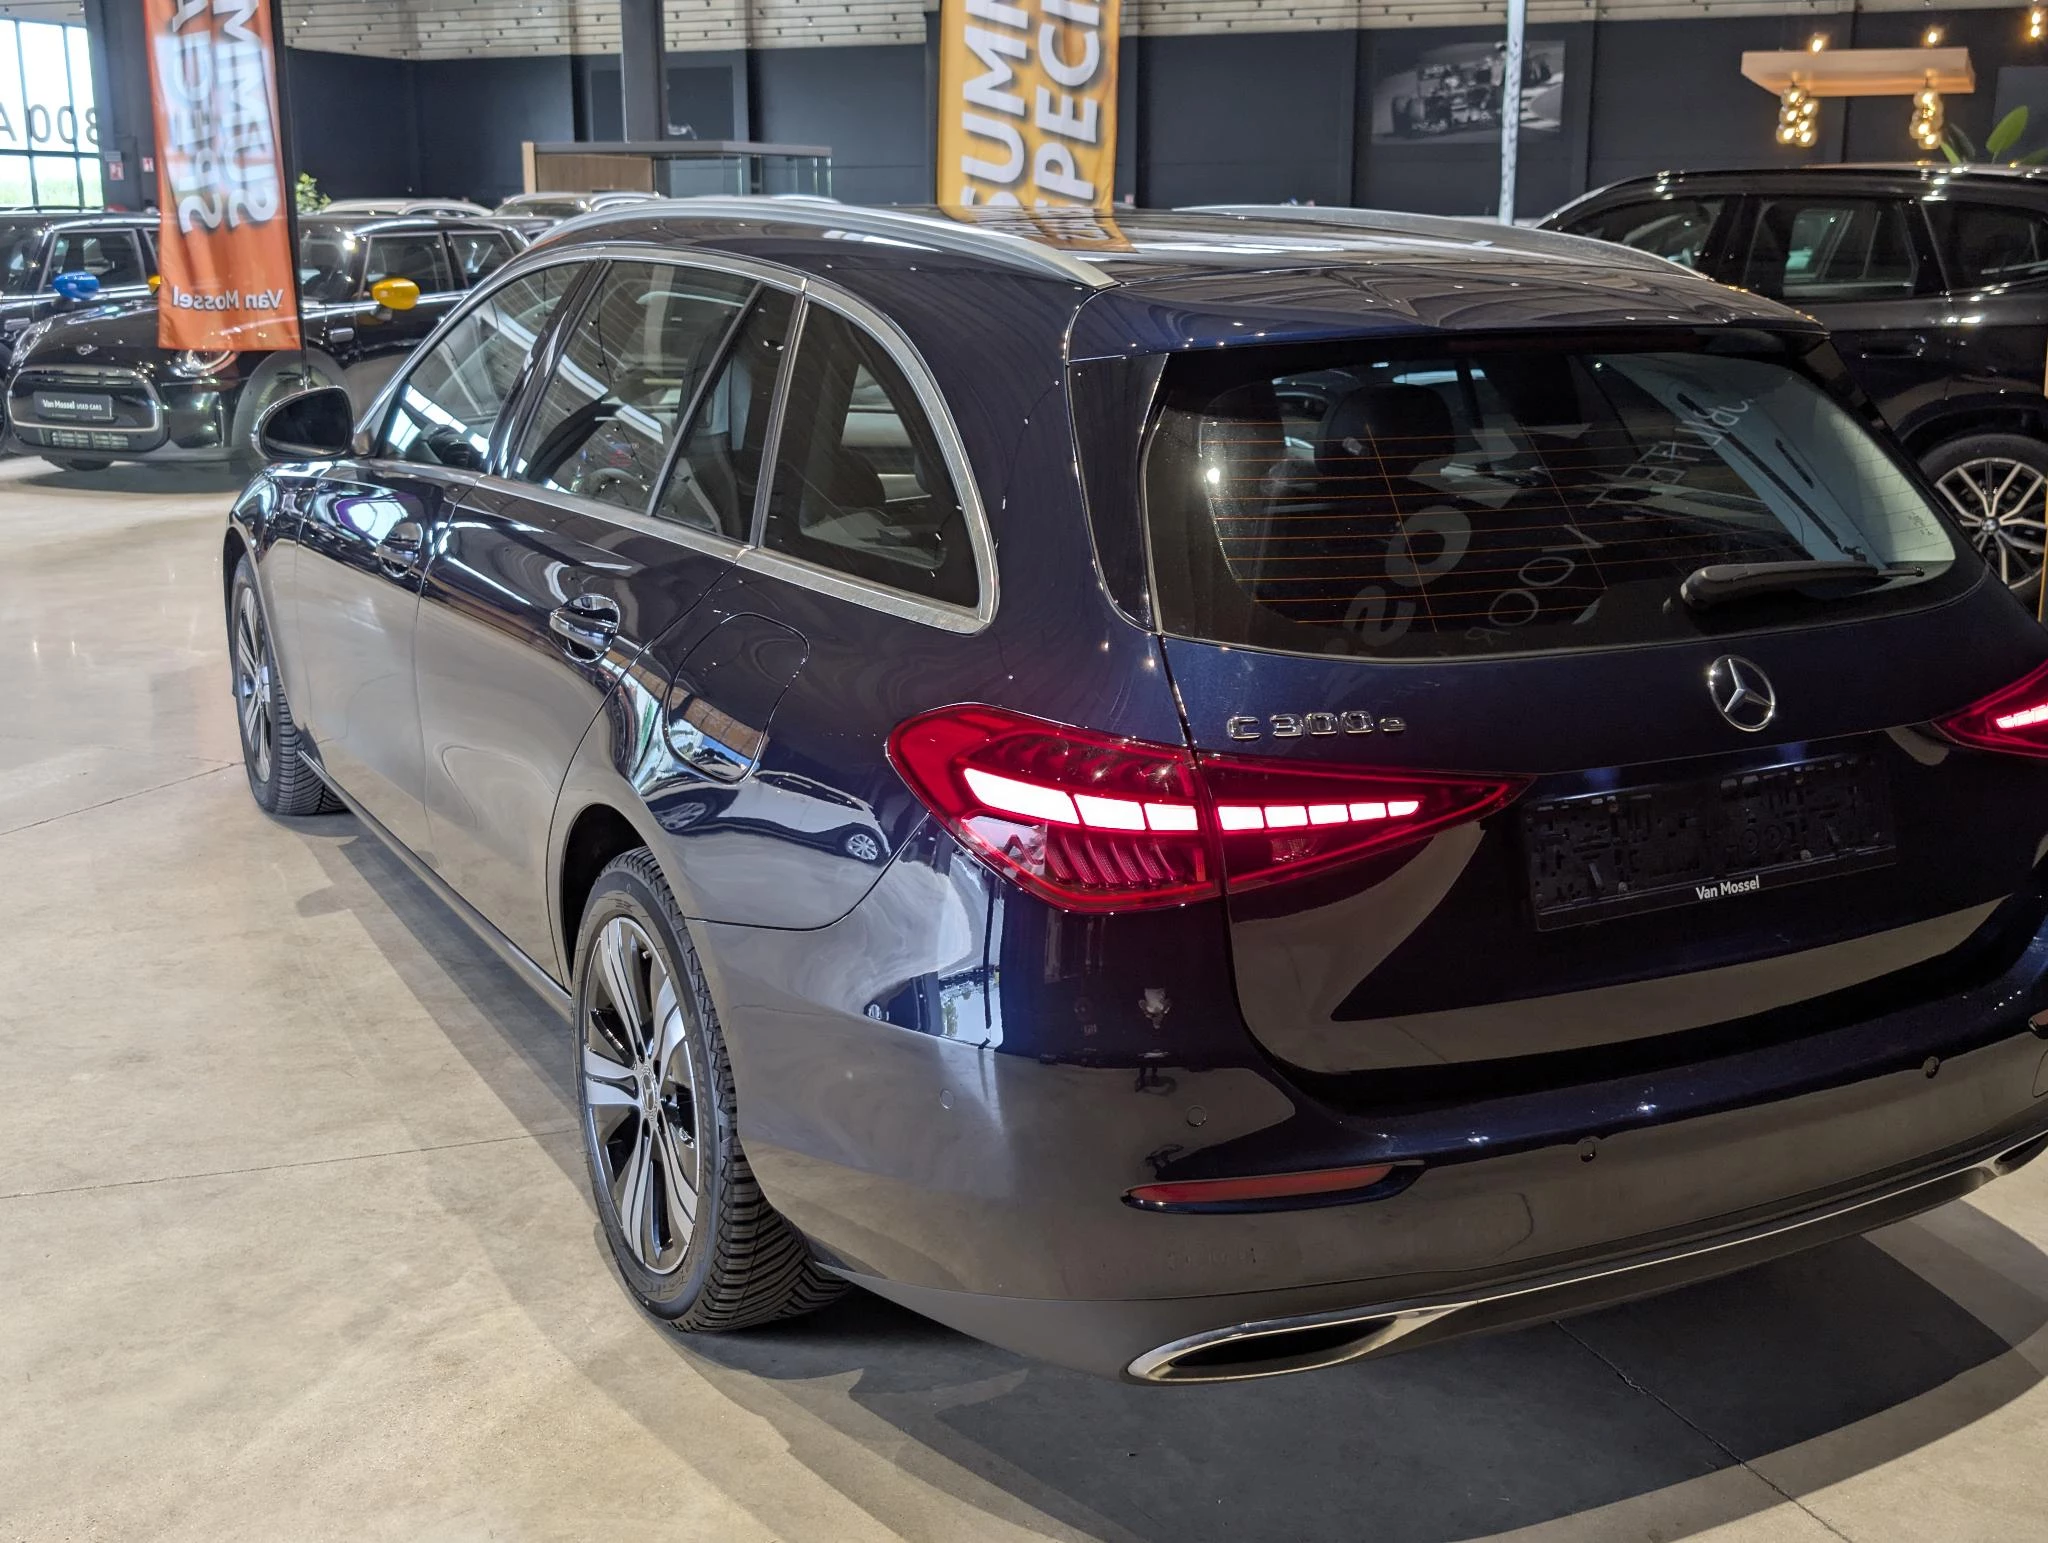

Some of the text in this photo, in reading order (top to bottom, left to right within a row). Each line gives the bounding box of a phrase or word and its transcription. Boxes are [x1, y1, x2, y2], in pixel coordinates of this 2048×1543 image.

[42, 399, 54, 408] Van
[54, 400, 75, 410] Mossel
[1227, 715, 1261, 739] C
[1695, 874, 1760, 900] Van Mossel
